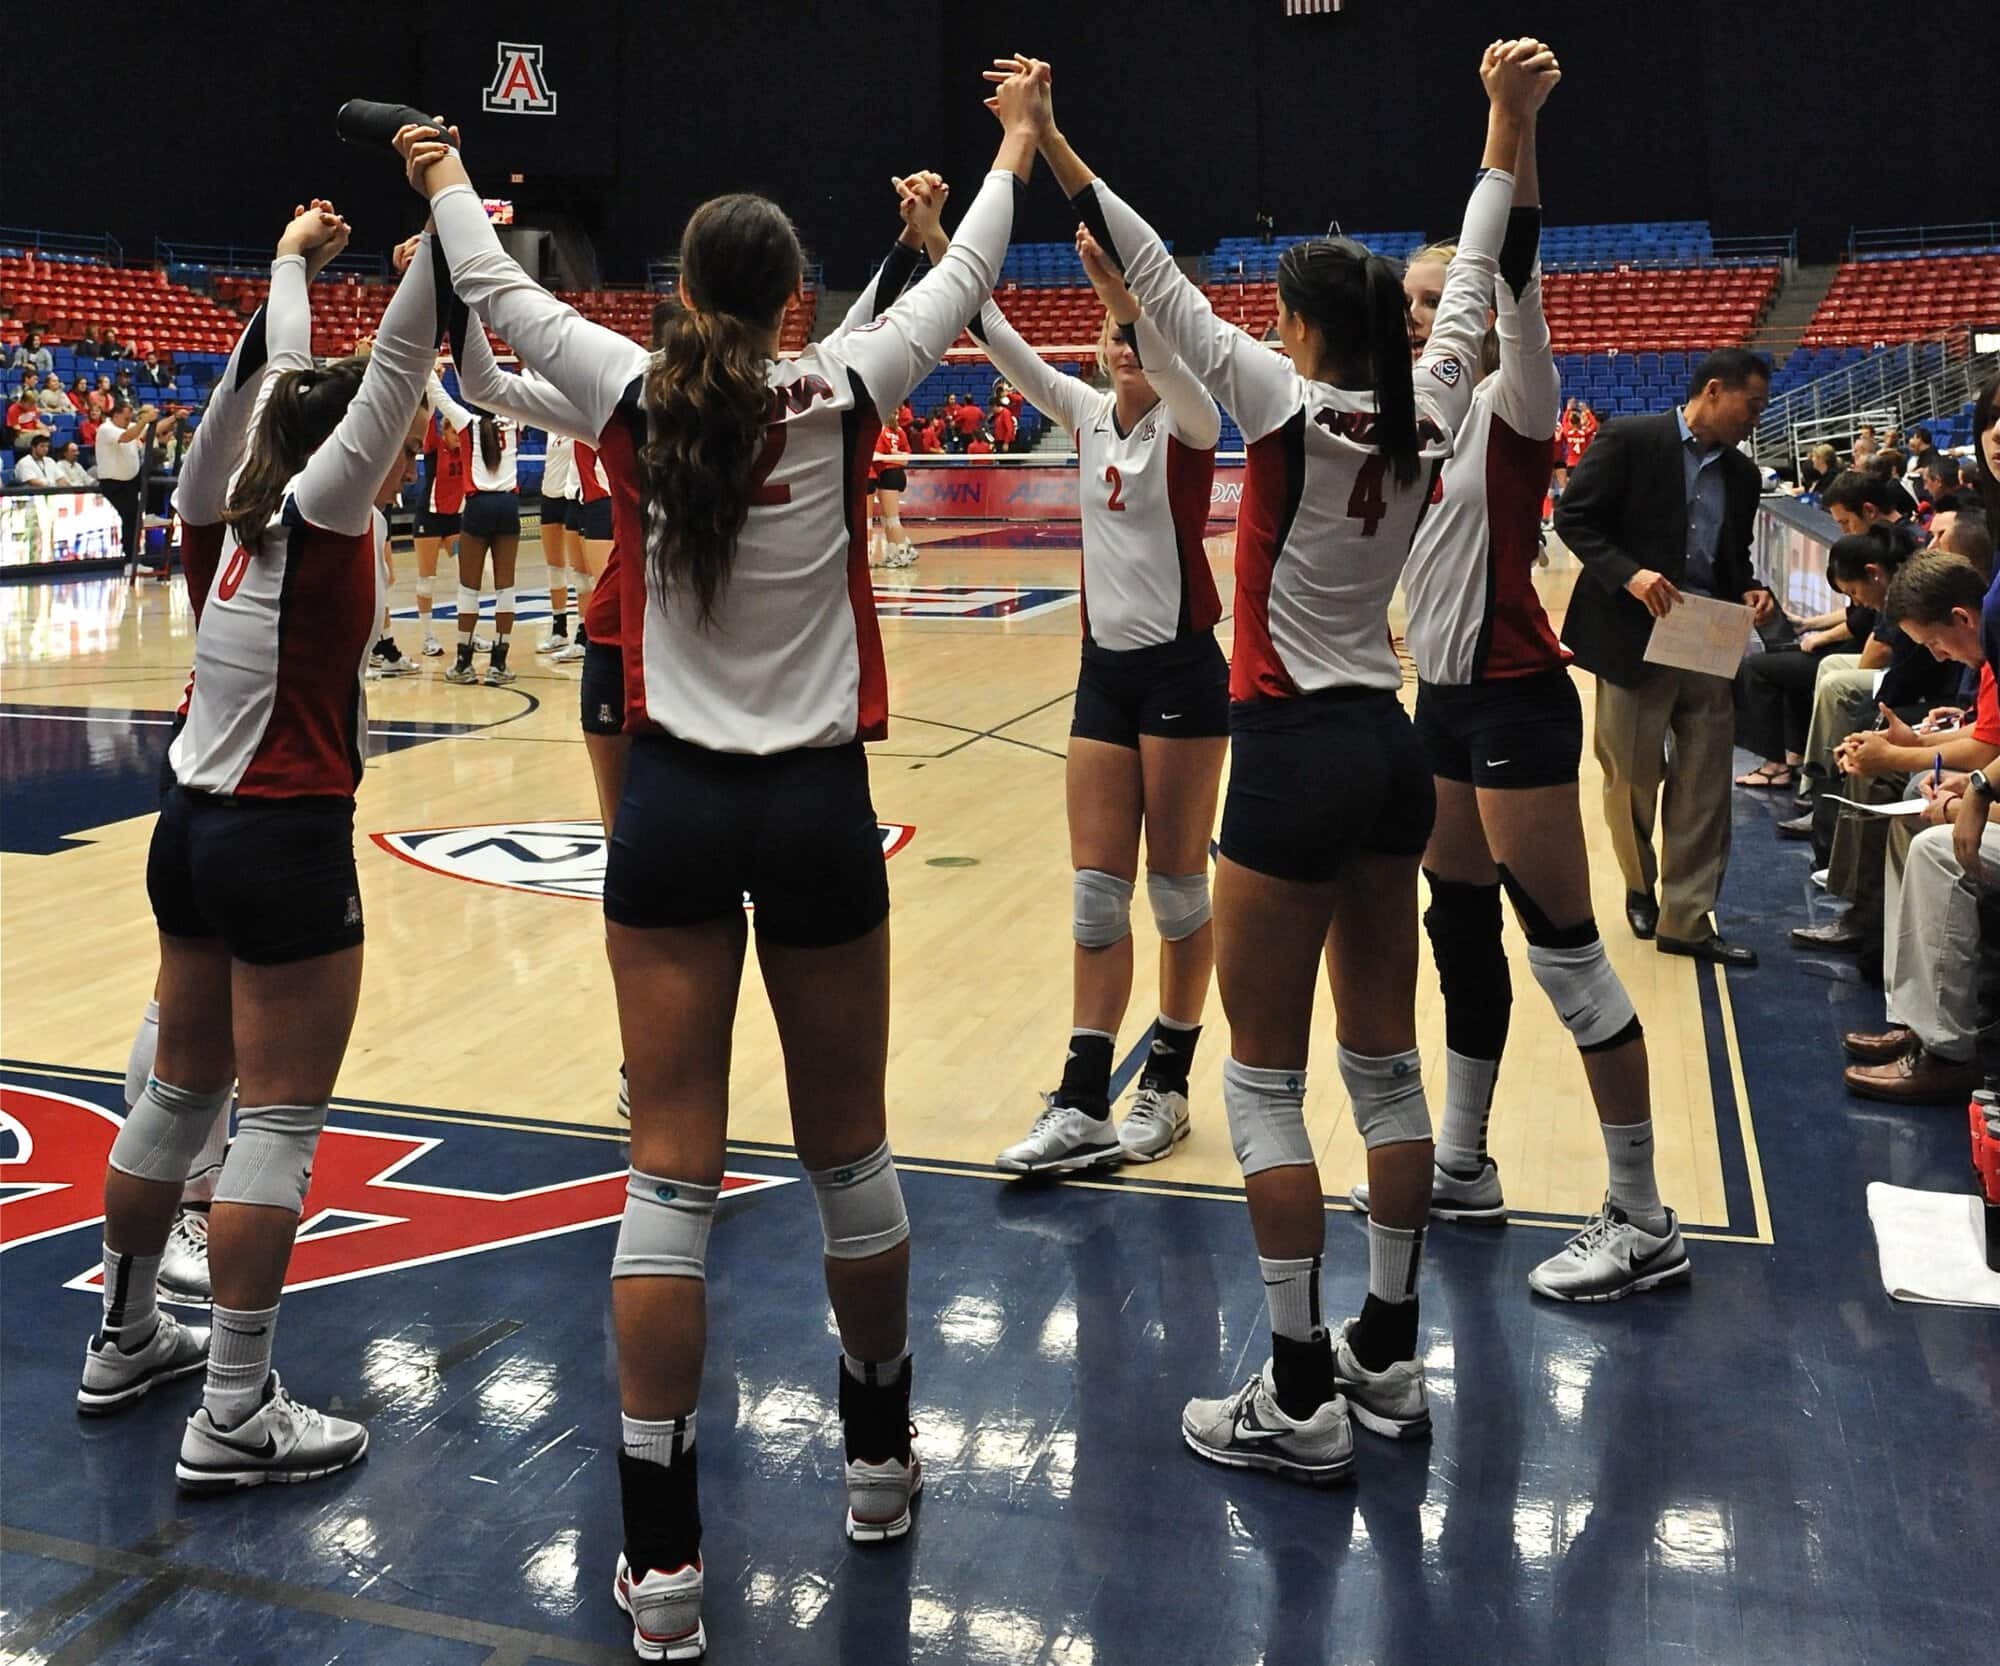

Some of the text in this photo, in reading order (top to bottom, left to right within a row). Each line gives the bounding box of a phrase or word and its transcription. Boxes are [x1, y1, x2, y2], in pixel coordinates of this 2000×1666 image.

[483, 41, 557, 115] A
[1105, 466, 1125, 511] 2
[1347, 455, 1387, 537] 4
